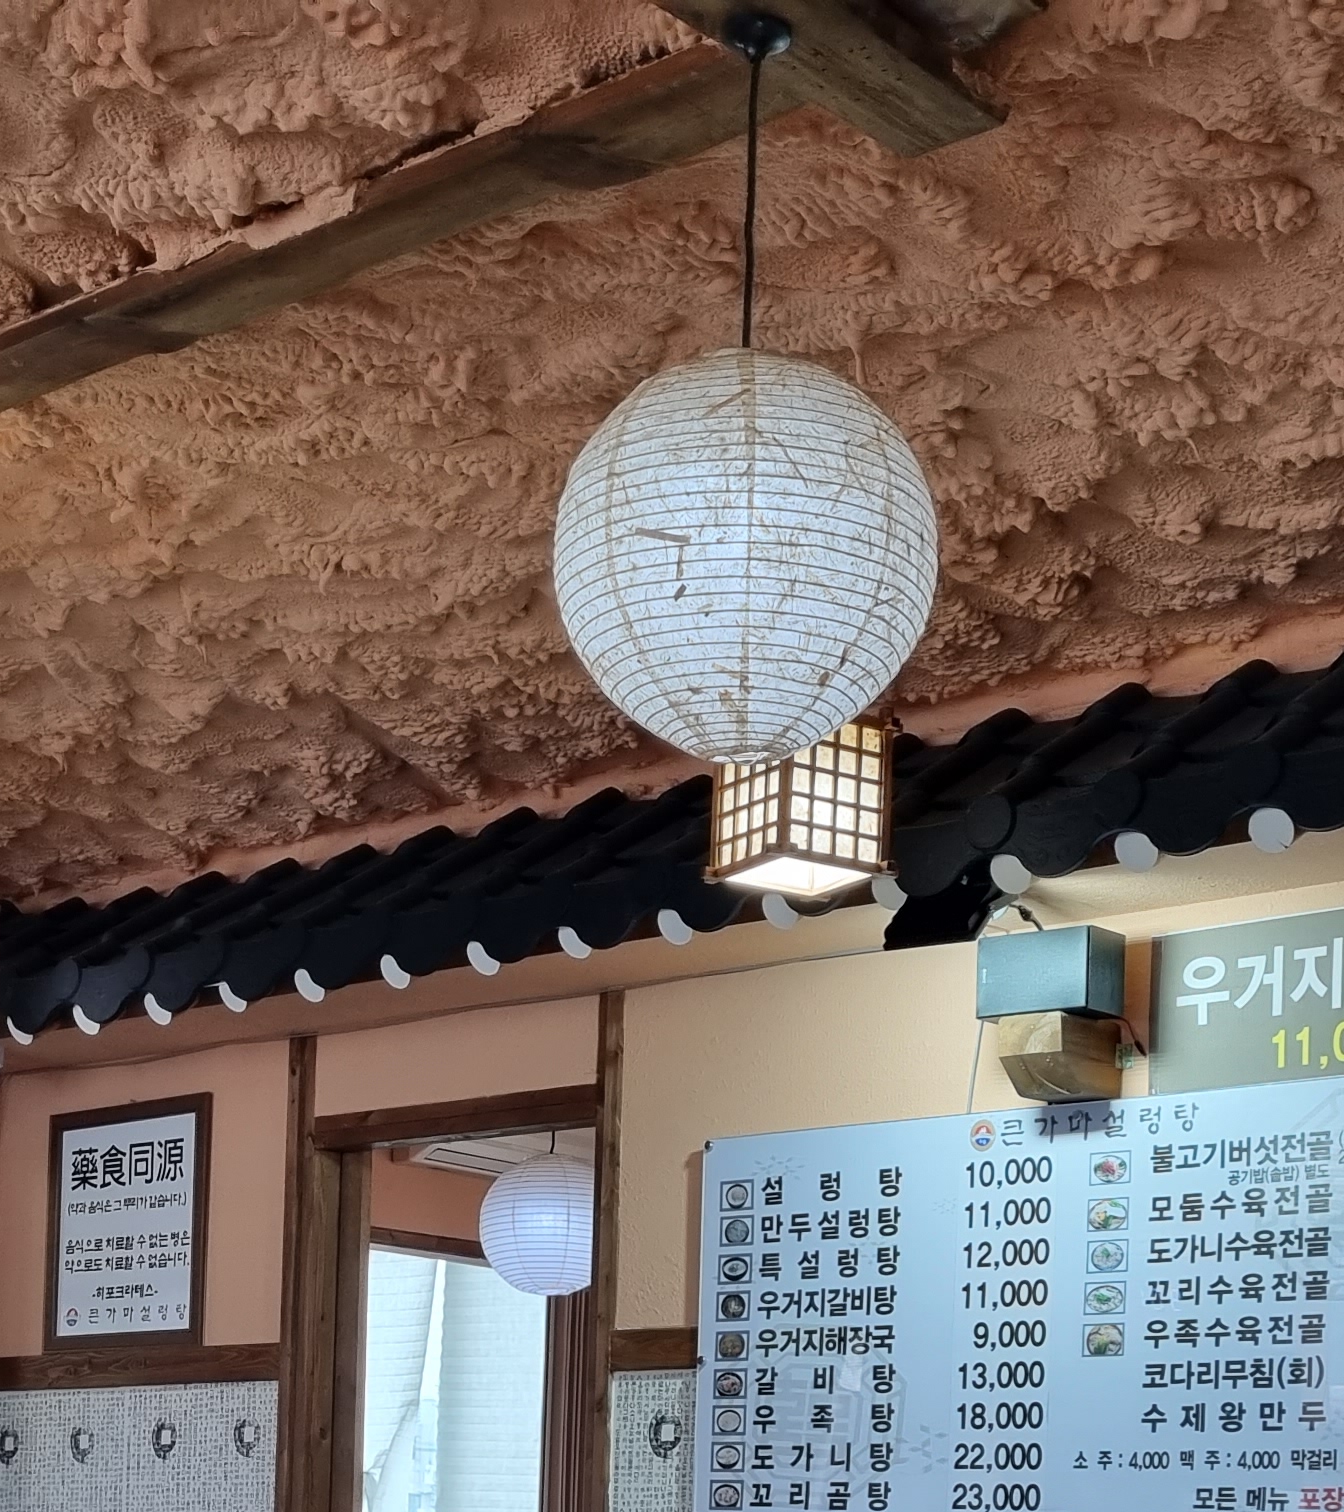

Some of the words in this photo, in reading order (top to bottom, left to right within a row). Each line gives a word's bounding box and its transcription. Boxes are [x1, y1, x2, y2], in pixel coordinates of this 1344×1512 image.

[71, 1138, 185, 1191] 藥食同源
[1150, 1130, 1334, 1173] 불고기버섯전골
[966, 1156, 1052, 1189] 10,000
[964, 1197, 1051, 1230] 11,000
[65, 1238, 103, 1254] 음식으로
[105, 1235, 134, 1252] 치료할
[136, 1234, 146, 1250] 수
[148, 1232, 168, 1248] 없는
[170, 1230, 191, 1246] 병은
[963, 1238, 1050, 1270] 12,000
[1146, 1227, 1332, 1264] 도가니수육전골
[65, 1257, 103, 1273] 약으로도
[105, 1255, 133, 1271] 치료할
[135, 1254, 146, 1269] 수
[148, 1252, 190, 1269] 없습니다.
[757, 1286, 897, 1320] 우거지갈비탕
[962, 1279, 1049, 1312] 11,000
[756, 1326, 895, 1358] 우거지해장국
[973, 1320, 1047, 1350] 9,000
[958, 1361, 1045, 1392] 13,000
[1142, 1355, 1326, 1391] 코다리무침(회)
[956, 1402, 1044, 1432] 18,000
[954, 1443, 1043, 1473] 22,000
[1129, 1450, 1170, 1472] 4,000
[1238, 1450, 1280, 1472] 4,000
[1193, 1487, 1238, 1512] 모든
[1246, 1487, 1290, 1512] 메뉴
